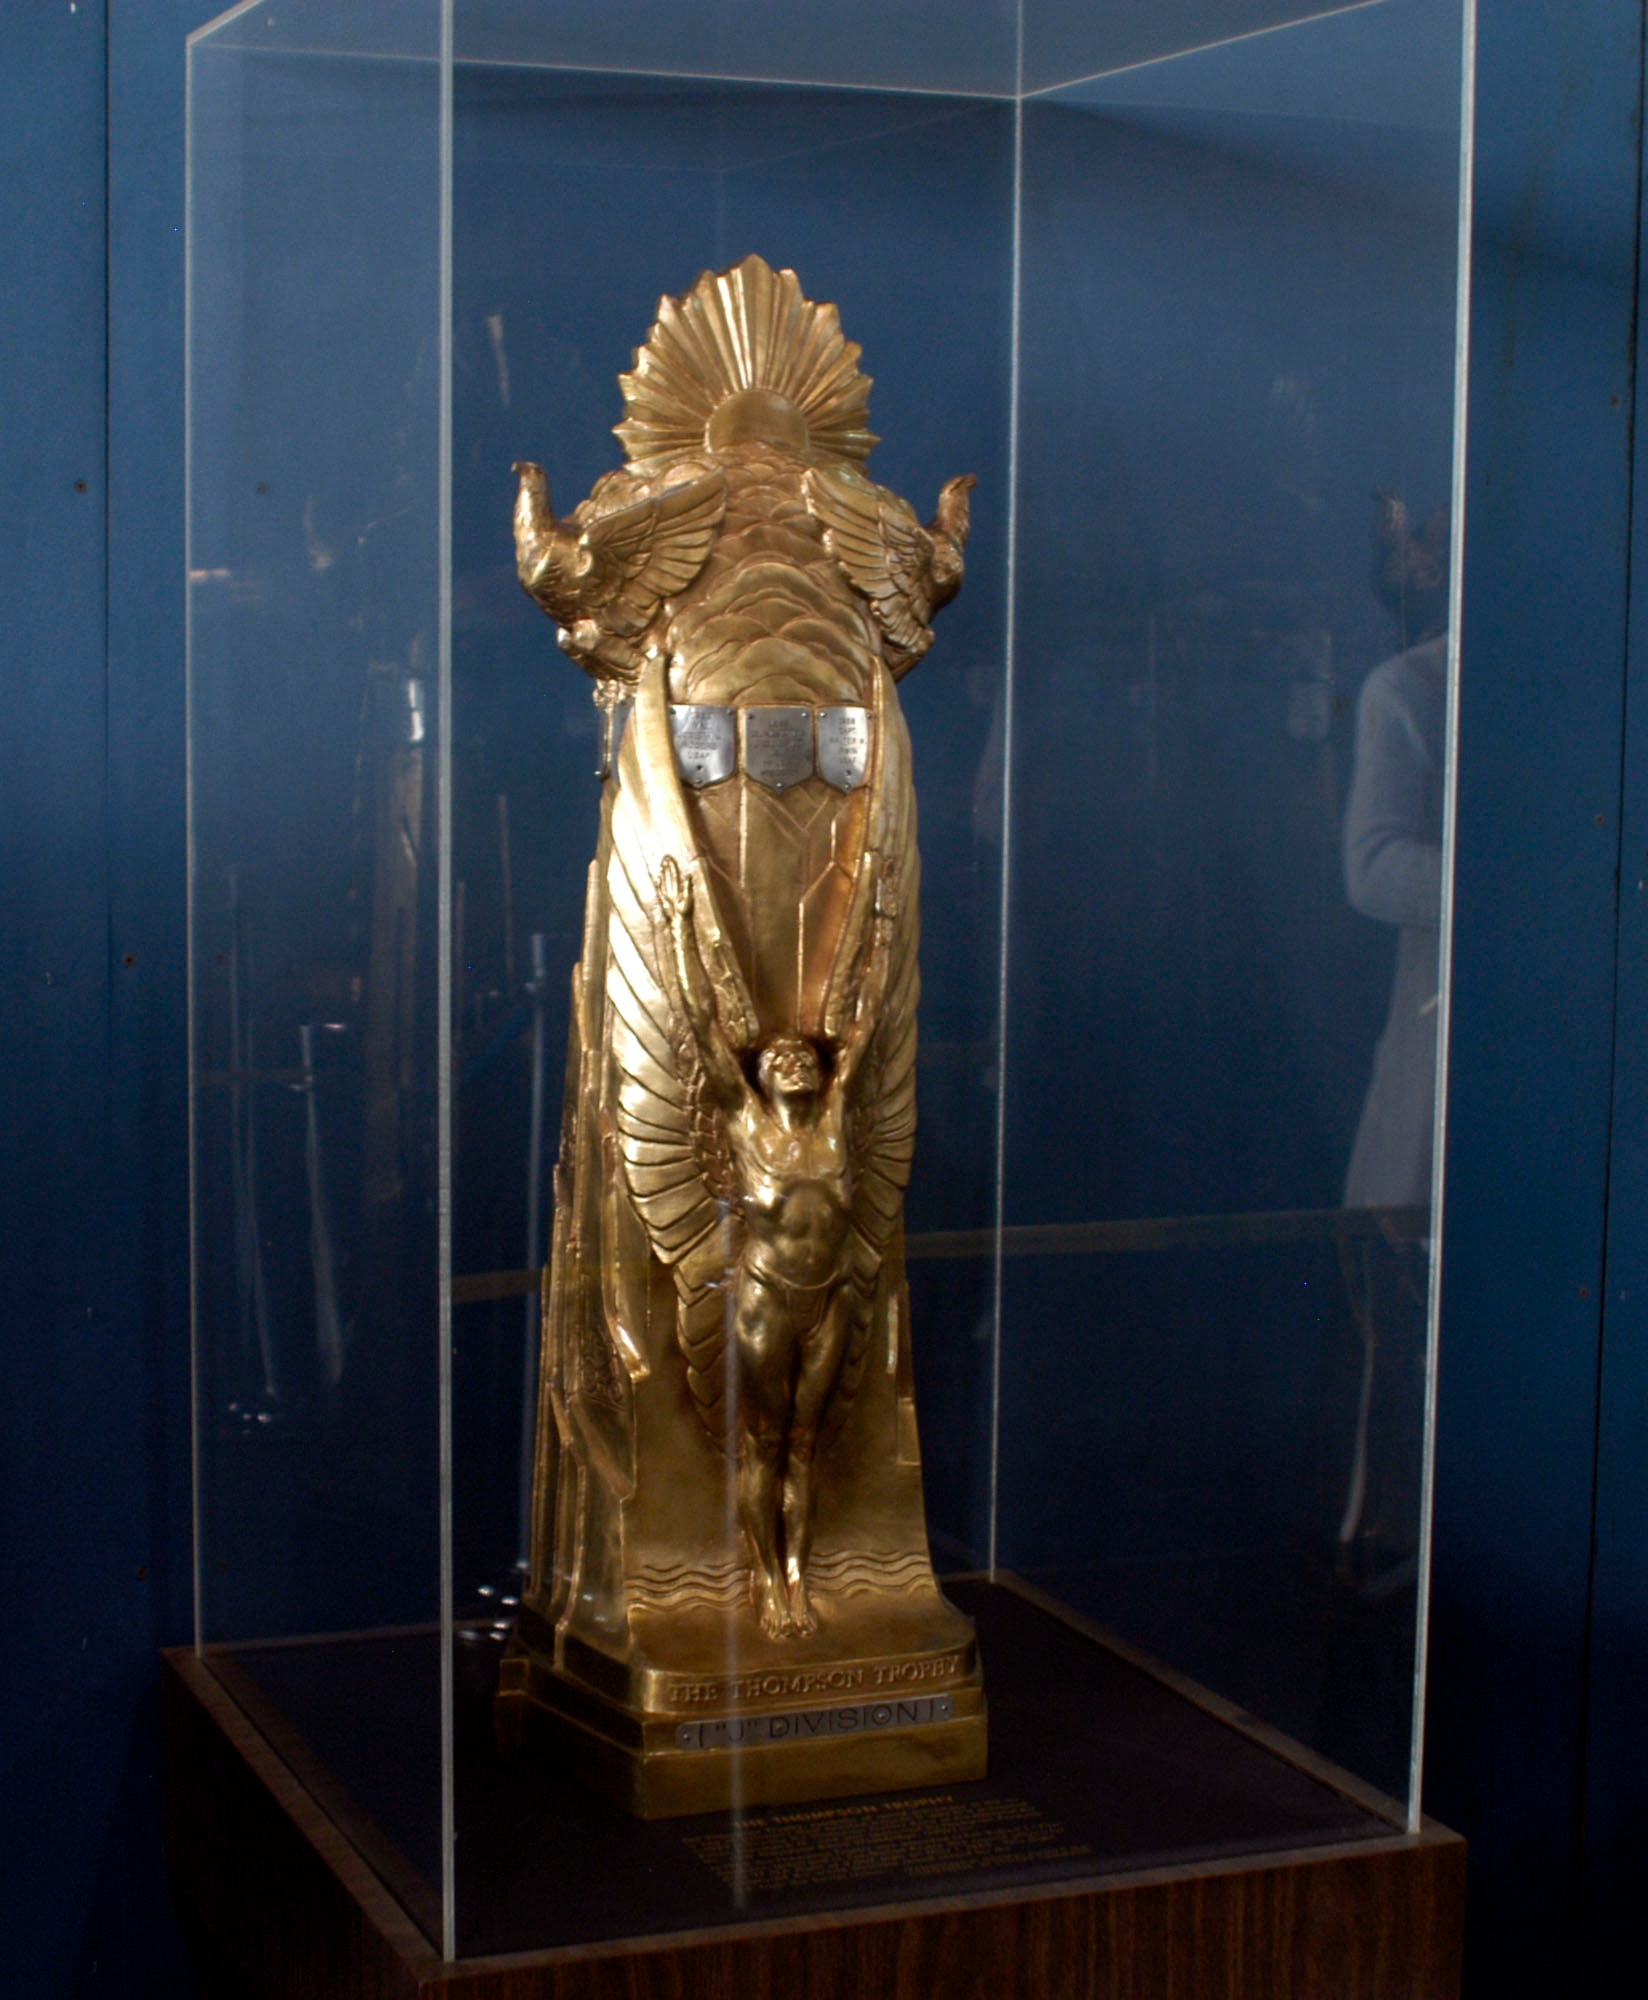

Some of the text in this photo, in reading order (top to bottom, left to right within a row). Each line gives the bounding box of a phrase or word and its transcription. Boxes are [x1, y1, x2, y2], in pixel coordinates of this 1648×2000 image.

[671, 1655, 960, 1704] THE THOMPSON TROPHY
[769, 1700, 918, 1739] DIVISION
